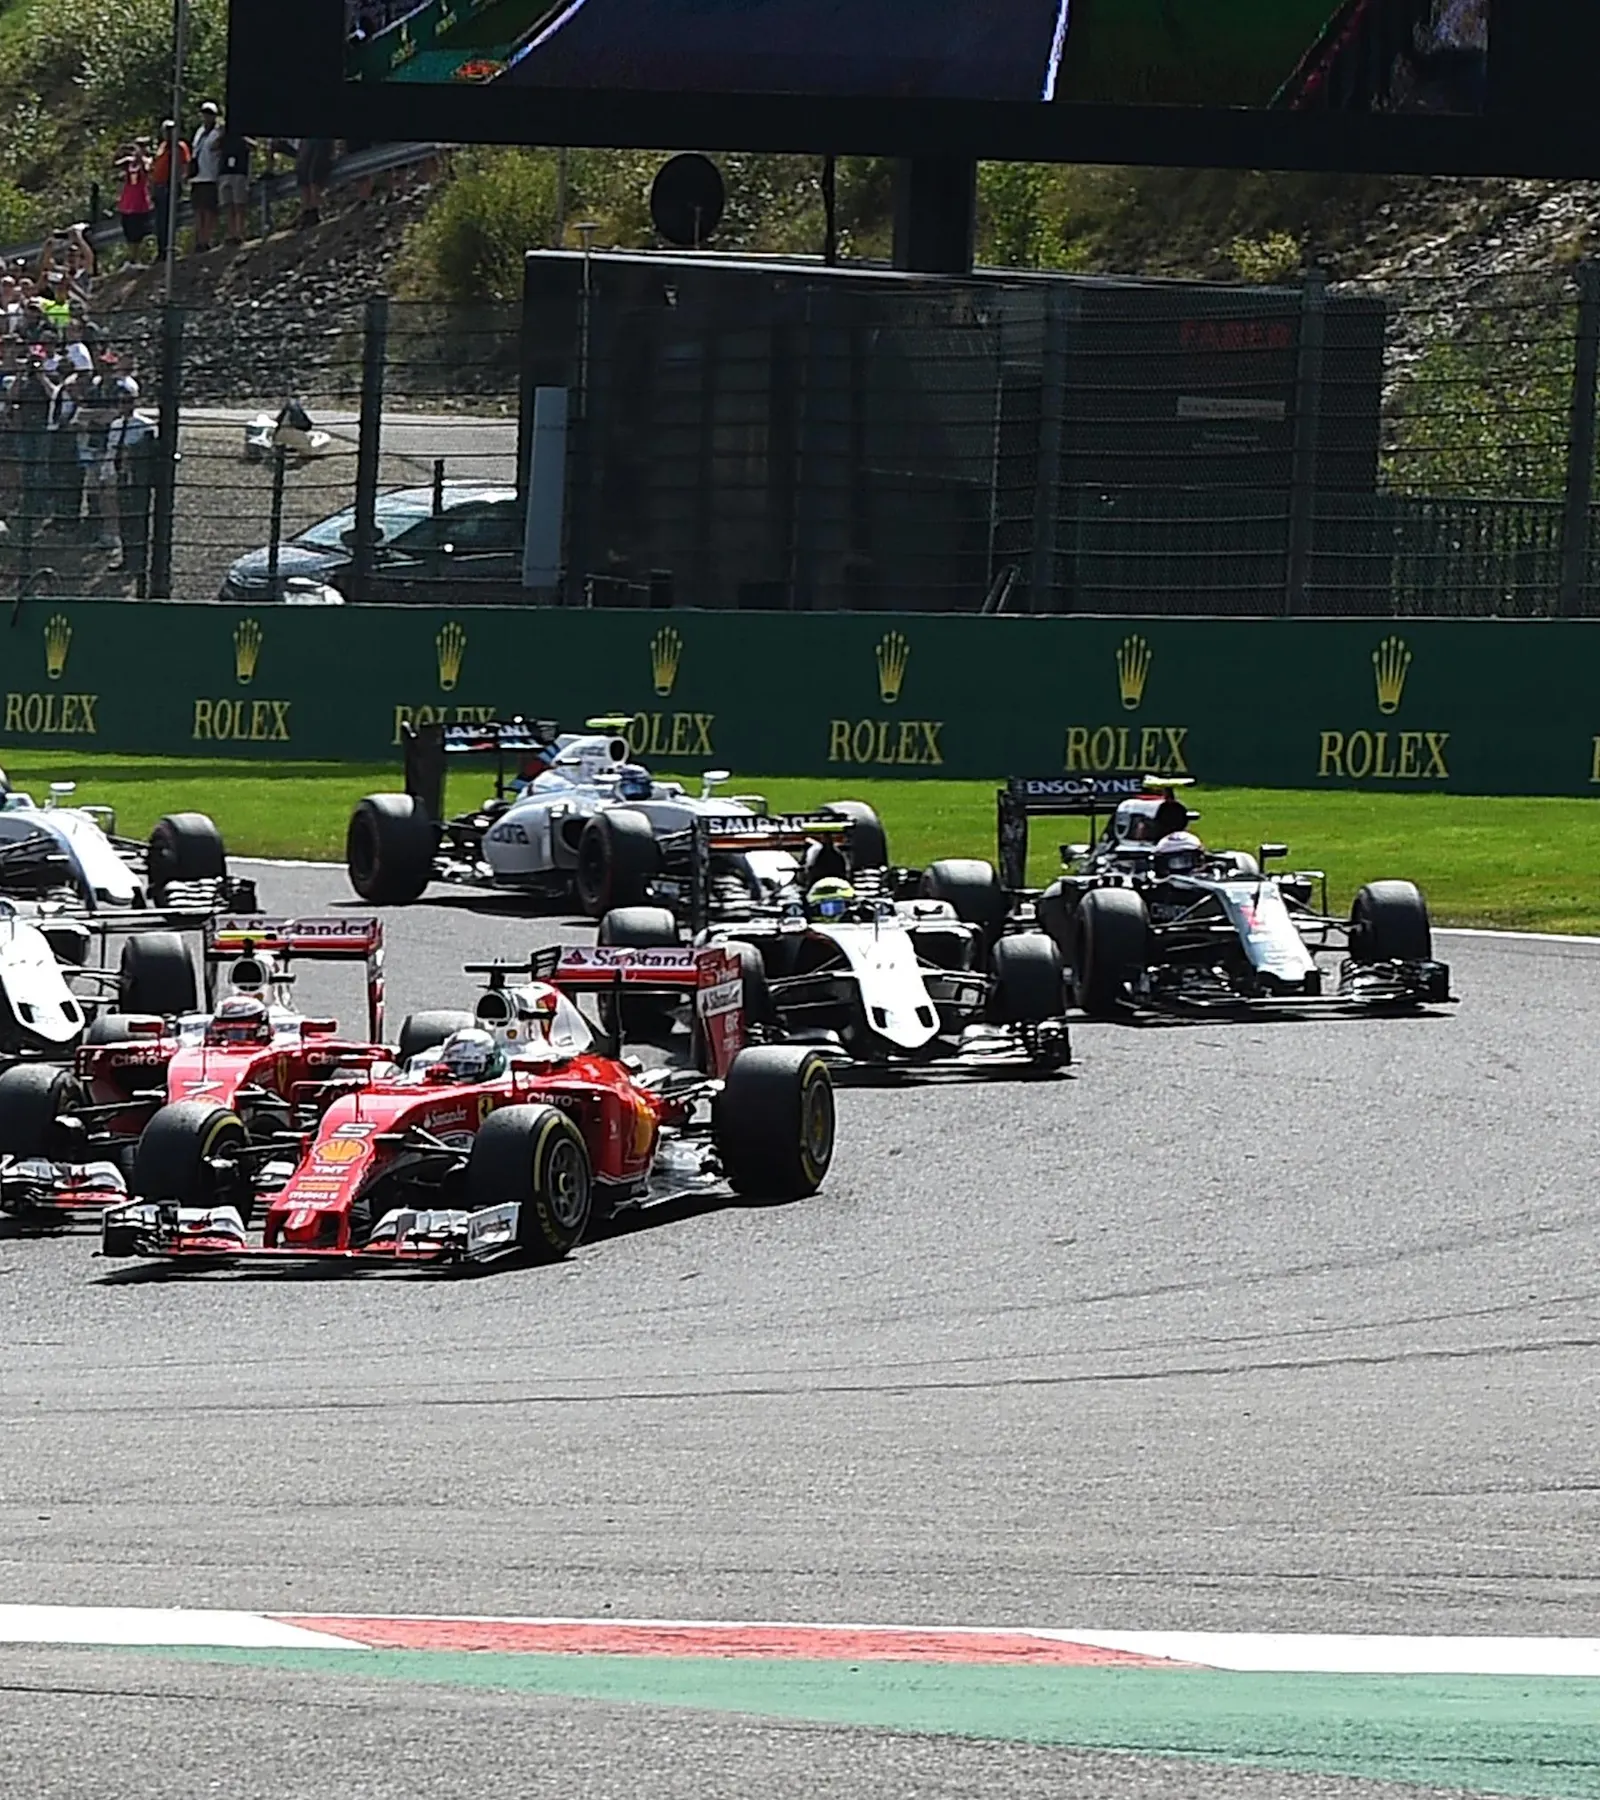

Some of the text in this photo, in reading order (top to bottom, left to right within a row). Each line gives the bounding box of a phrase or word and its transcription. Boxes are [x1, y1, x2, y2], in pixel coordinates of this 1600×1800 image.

[4, 693, 99, 734] ROLEX
[192, 699, 291, 741] ROLEX
[608, 712, 716, 756] OLEX
[828, 719, 945, 765] ROLEX
[1064, 727, 1190, 773] ROLEX
[1317, 730, 1450, 779] ROLEX
